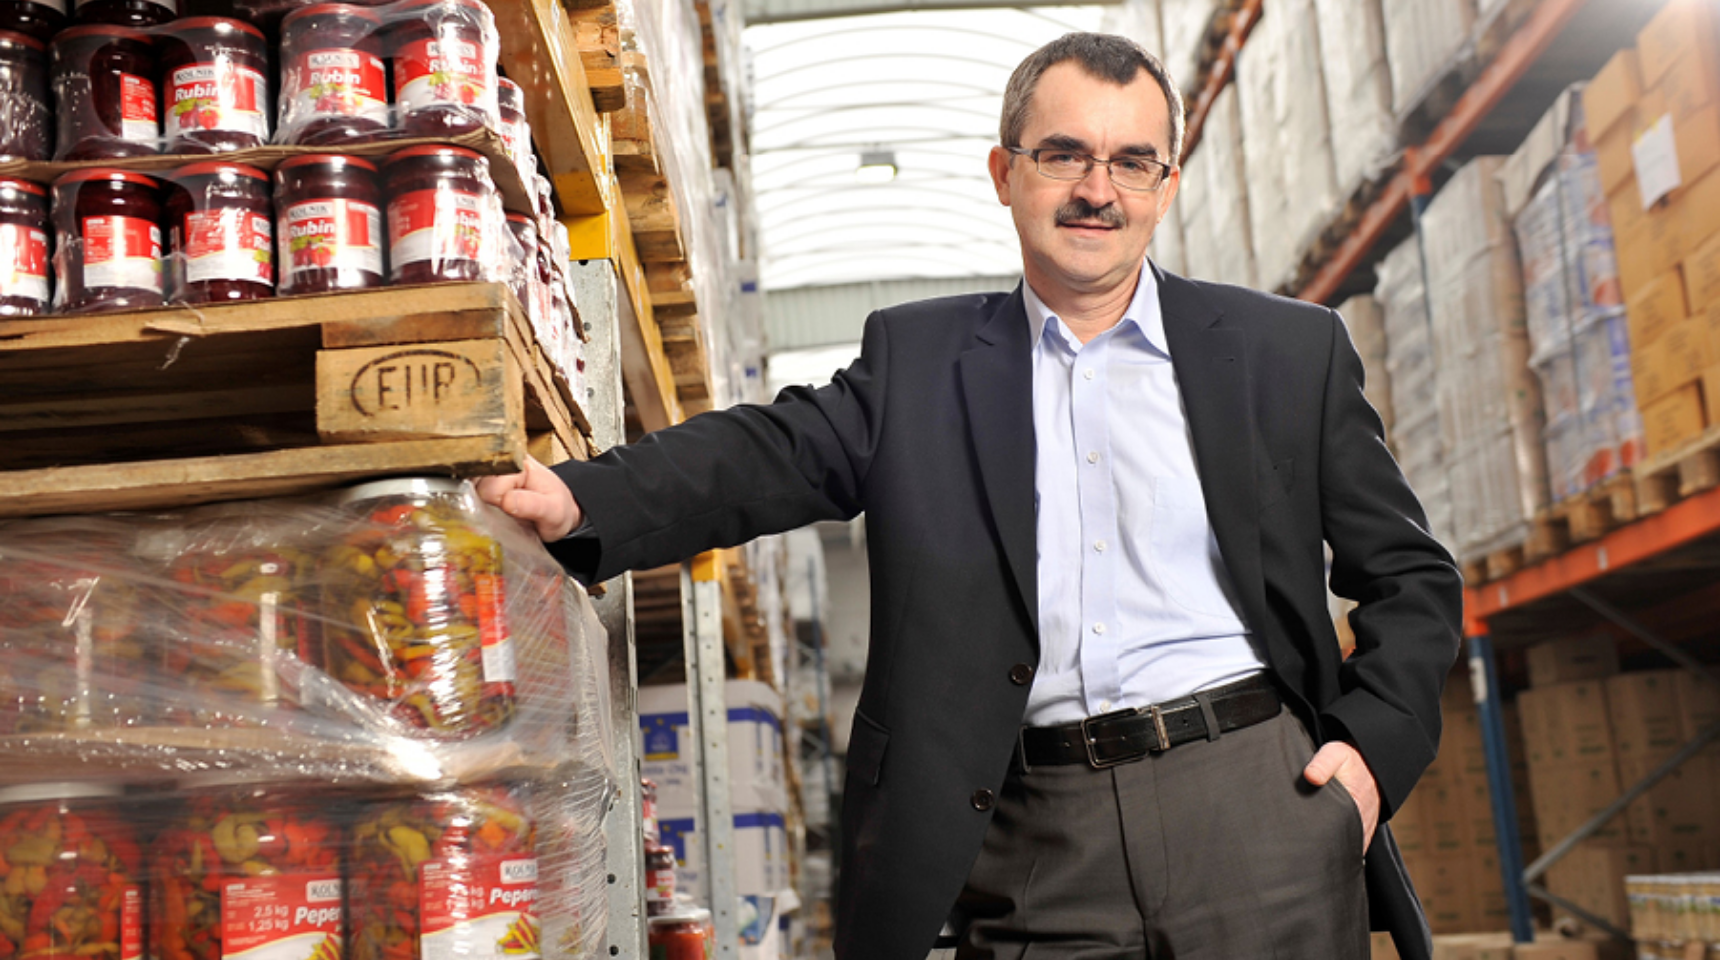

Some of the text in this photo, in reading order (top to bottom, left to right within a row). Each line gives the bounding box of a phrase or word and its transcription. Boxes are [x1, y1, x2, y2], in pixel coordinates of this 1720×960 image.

[309, 69, 361, 85] Rubin
[289, 219, 337, 238] Rubin
[253, 904, 273, 919] 2,5
[274, 904, 289, 918] kg
[248, 918, 273, 933] 1,25
[274, 918, 289, 932] kg
